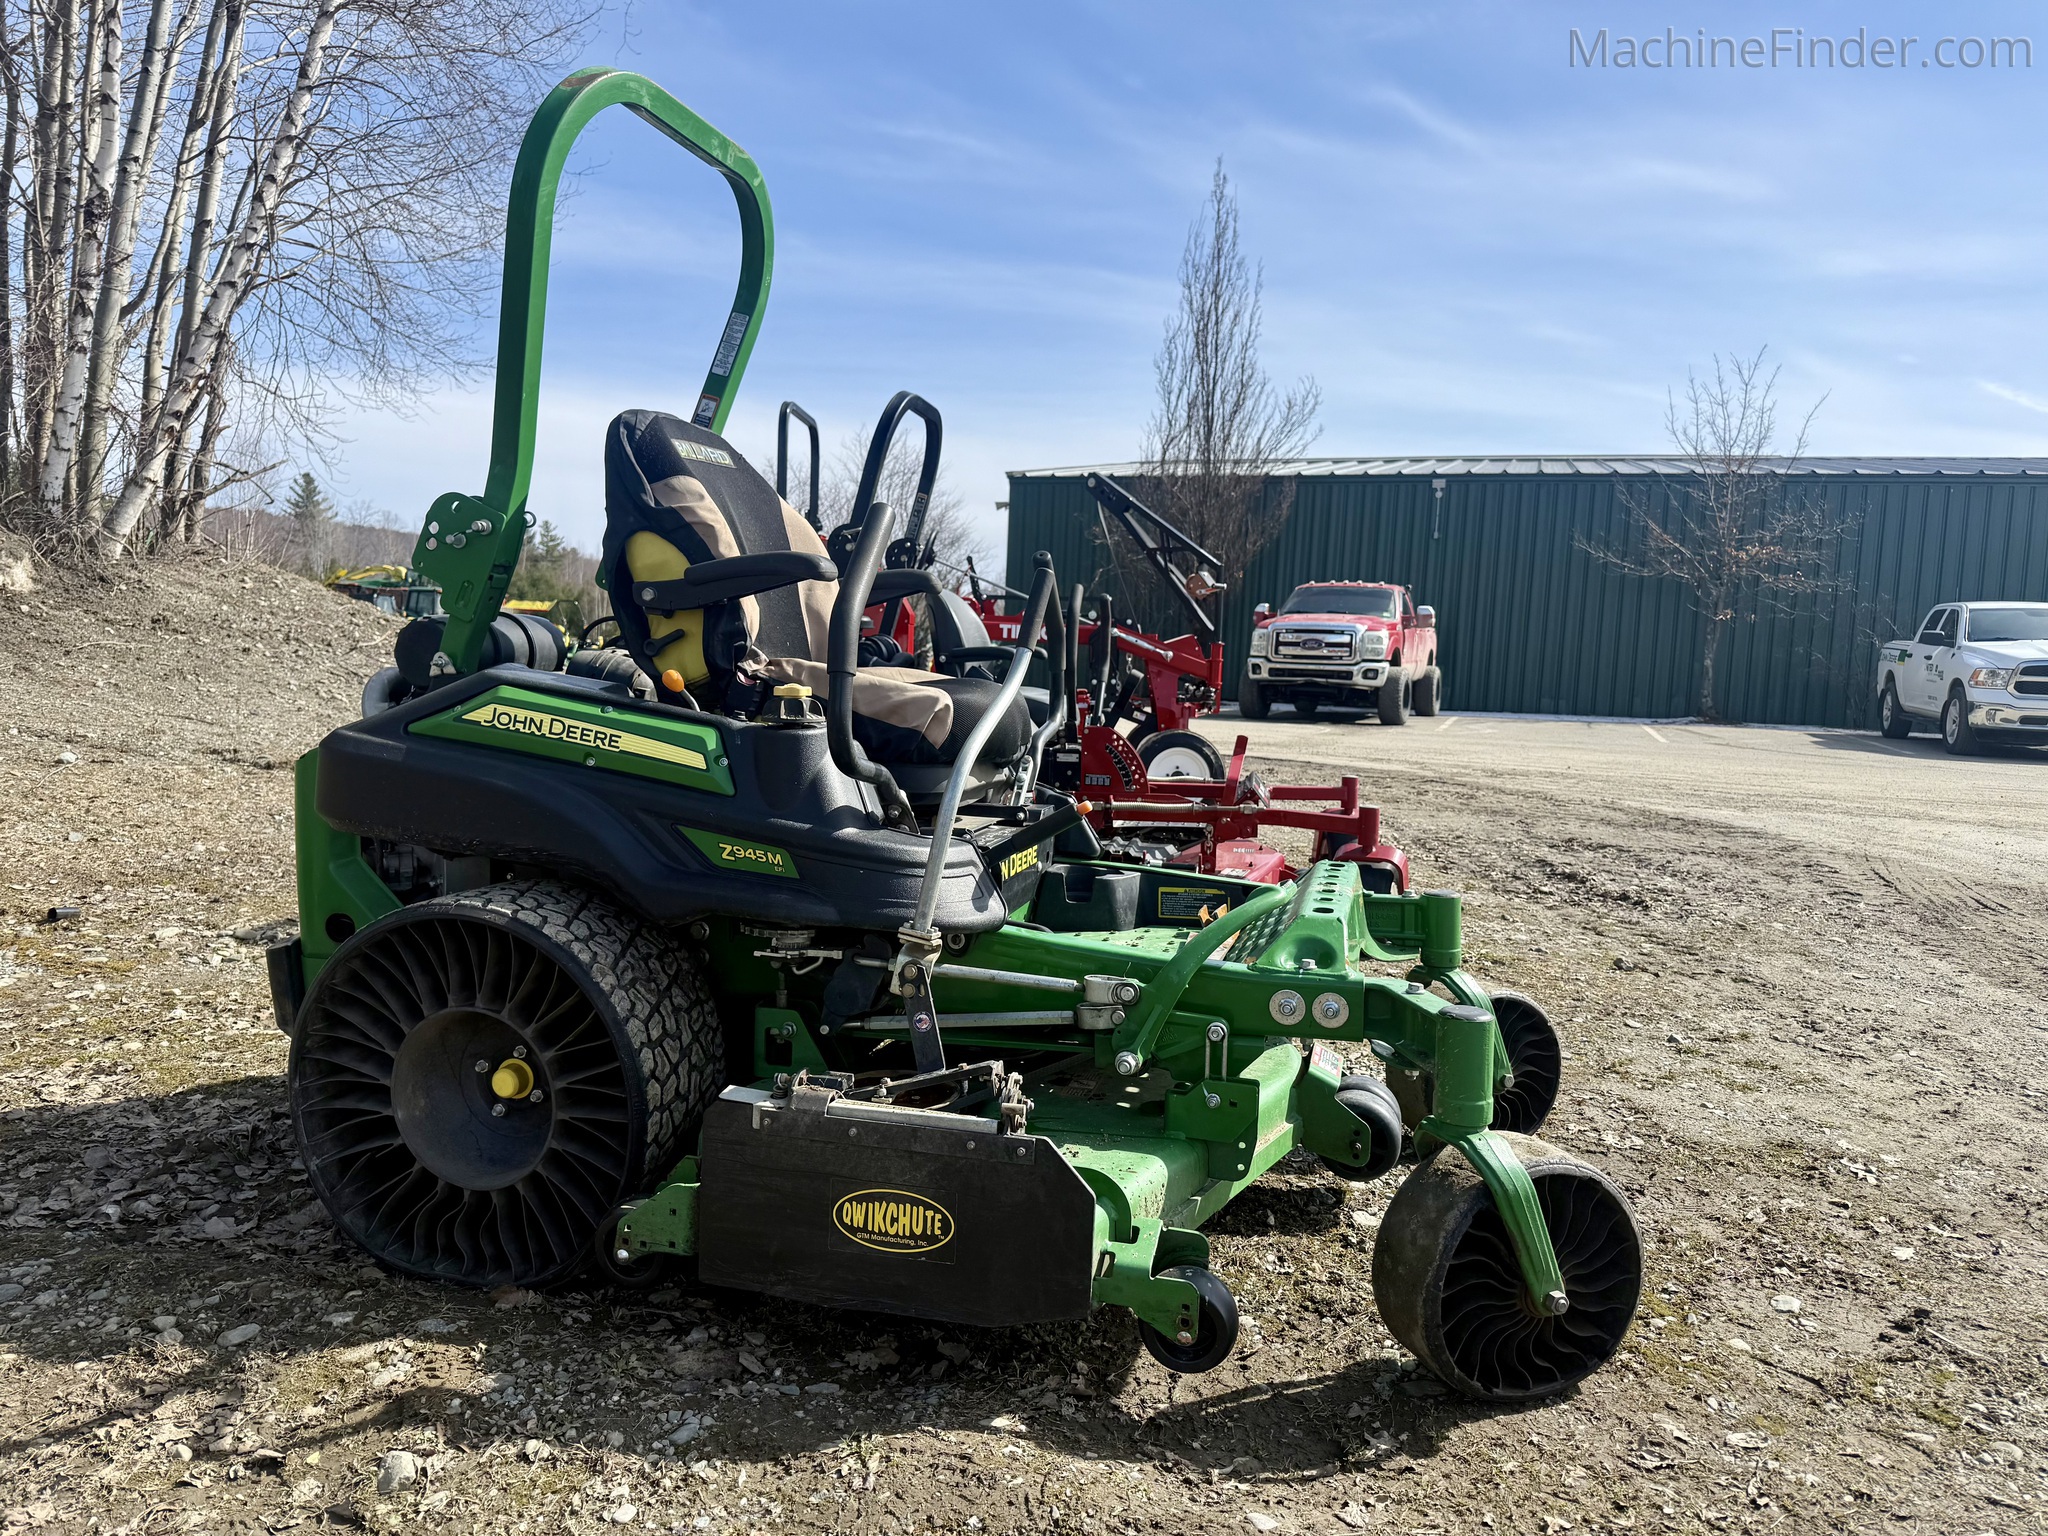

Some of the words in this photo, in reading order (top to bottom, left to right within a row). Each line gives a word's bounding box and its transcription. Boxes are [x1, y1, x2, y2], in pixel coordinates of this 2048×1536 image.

[483, 707, 543, 733] JOHN
[548, 718, 622, 749] DEERE
[718, 843, 783, 866] Z945M
[1010, 844, 1038, 877] DEERE
[842, 1201, 942, 1236] QWIKCHUTE
